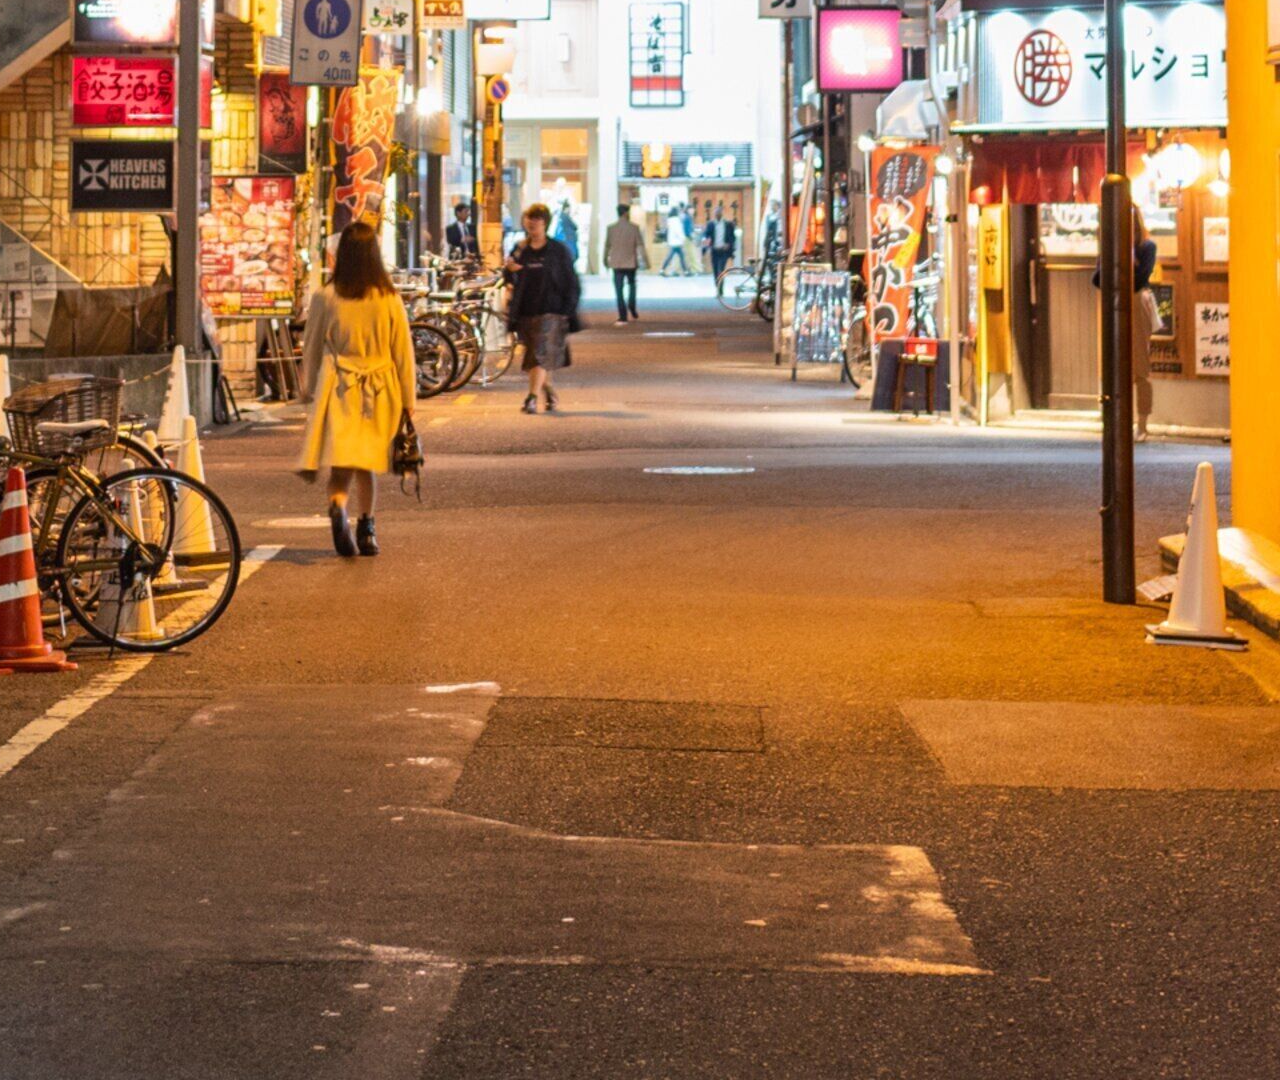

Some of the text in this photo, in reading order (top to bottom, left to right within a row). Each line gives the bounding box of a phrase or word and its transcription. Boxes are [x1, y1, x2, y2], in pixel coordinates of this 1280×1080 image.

[298, 49, 352, 64] この先
[1084, 46, 1227, 82] マルショ
[323, 68, 352, 81] 40m
[110, 158, 167, 174] HEAVENS
[109, 174, 167, 190] KITCHEN
